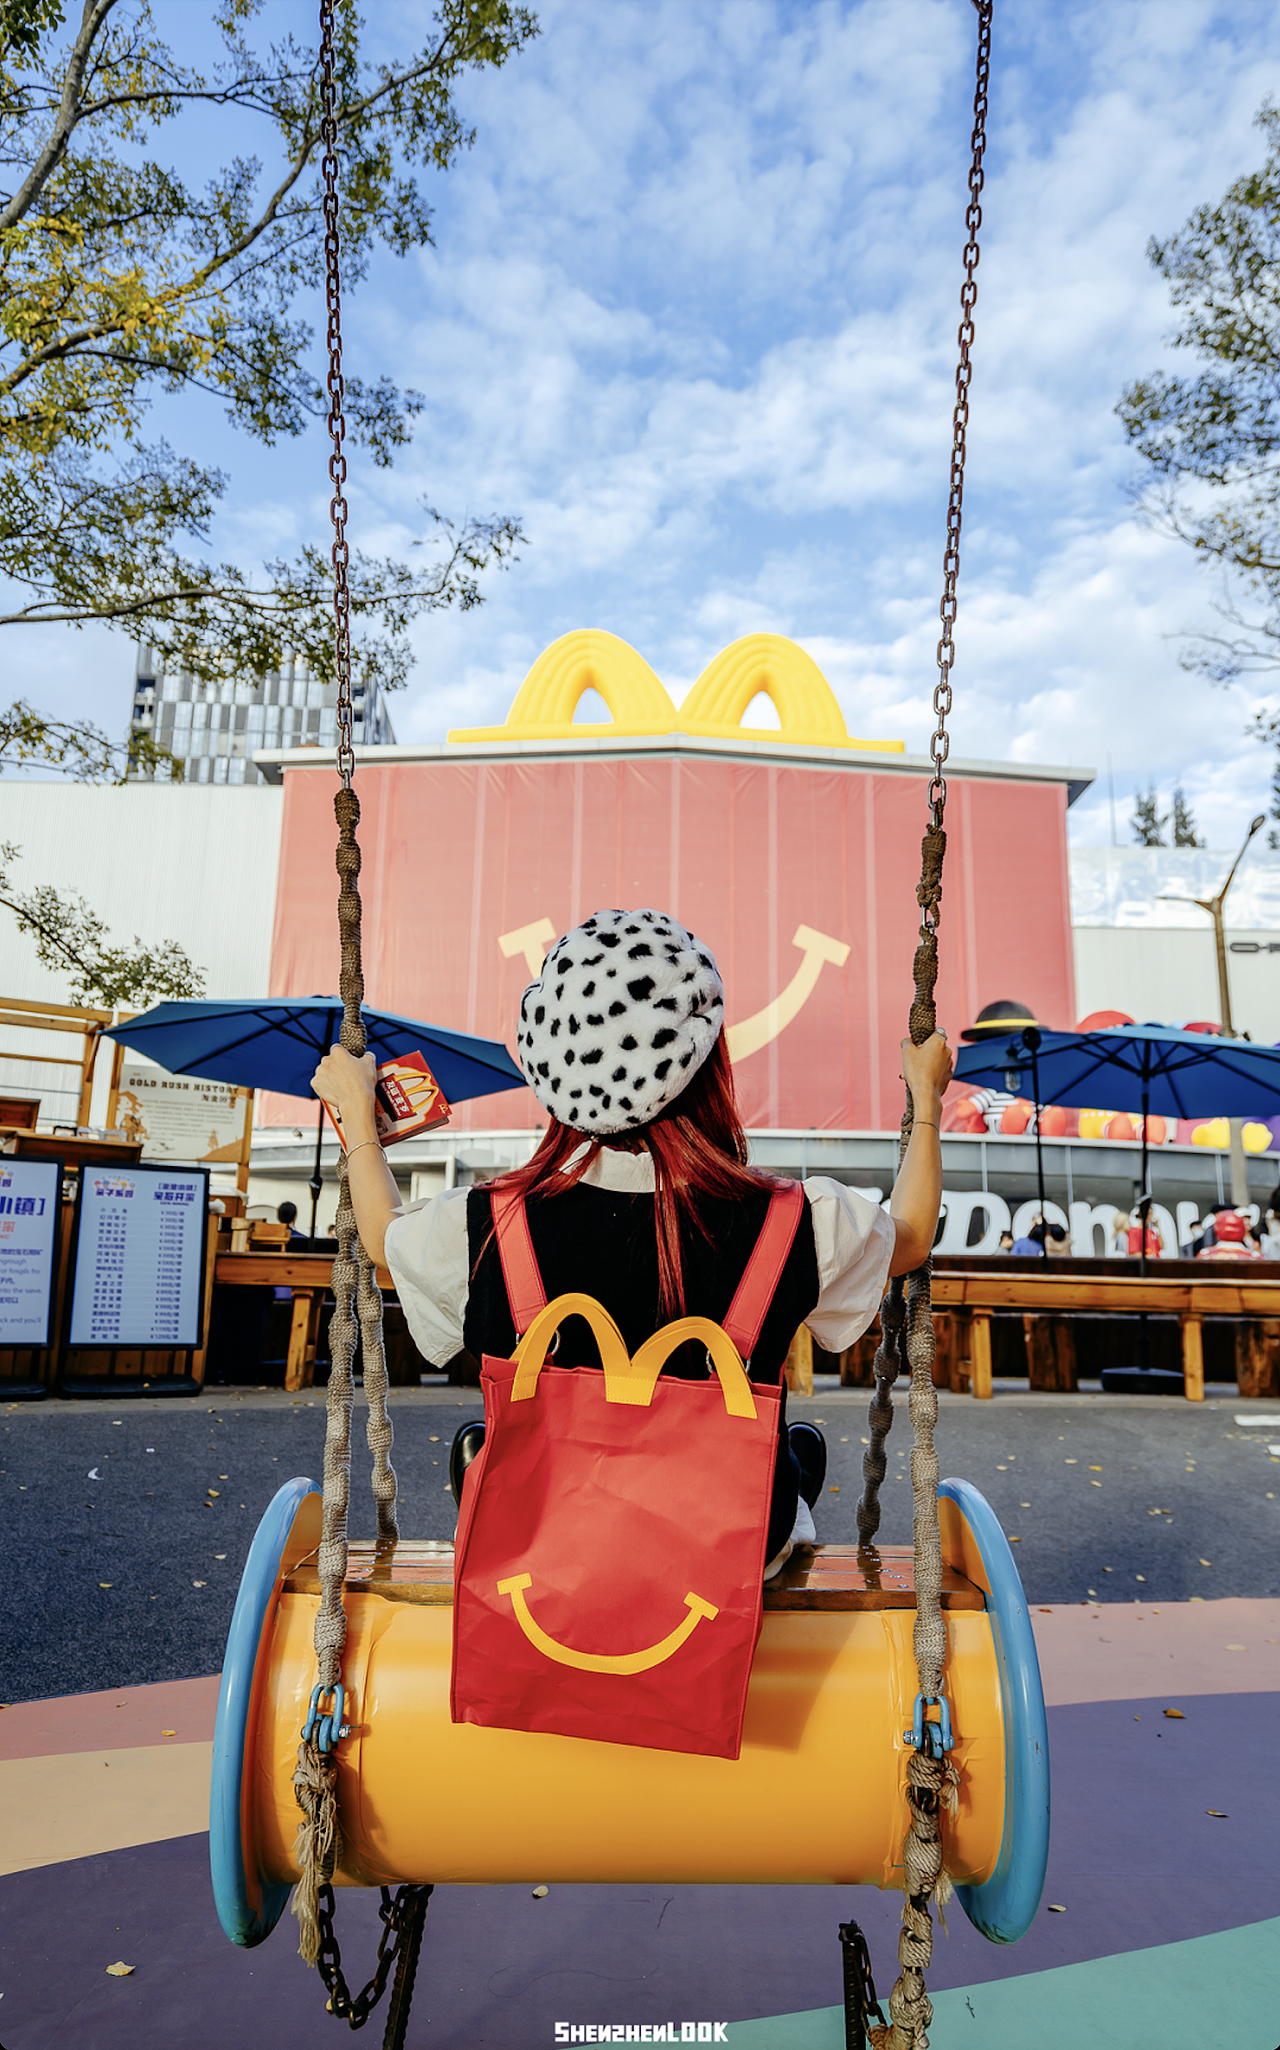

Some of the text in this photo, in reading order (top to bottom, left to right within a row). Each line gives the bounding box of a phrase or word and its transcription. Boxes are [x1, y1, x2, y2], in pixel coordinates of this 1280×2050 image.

[129, 1078, 239, 1094] GOLD RUSH HISTORY
